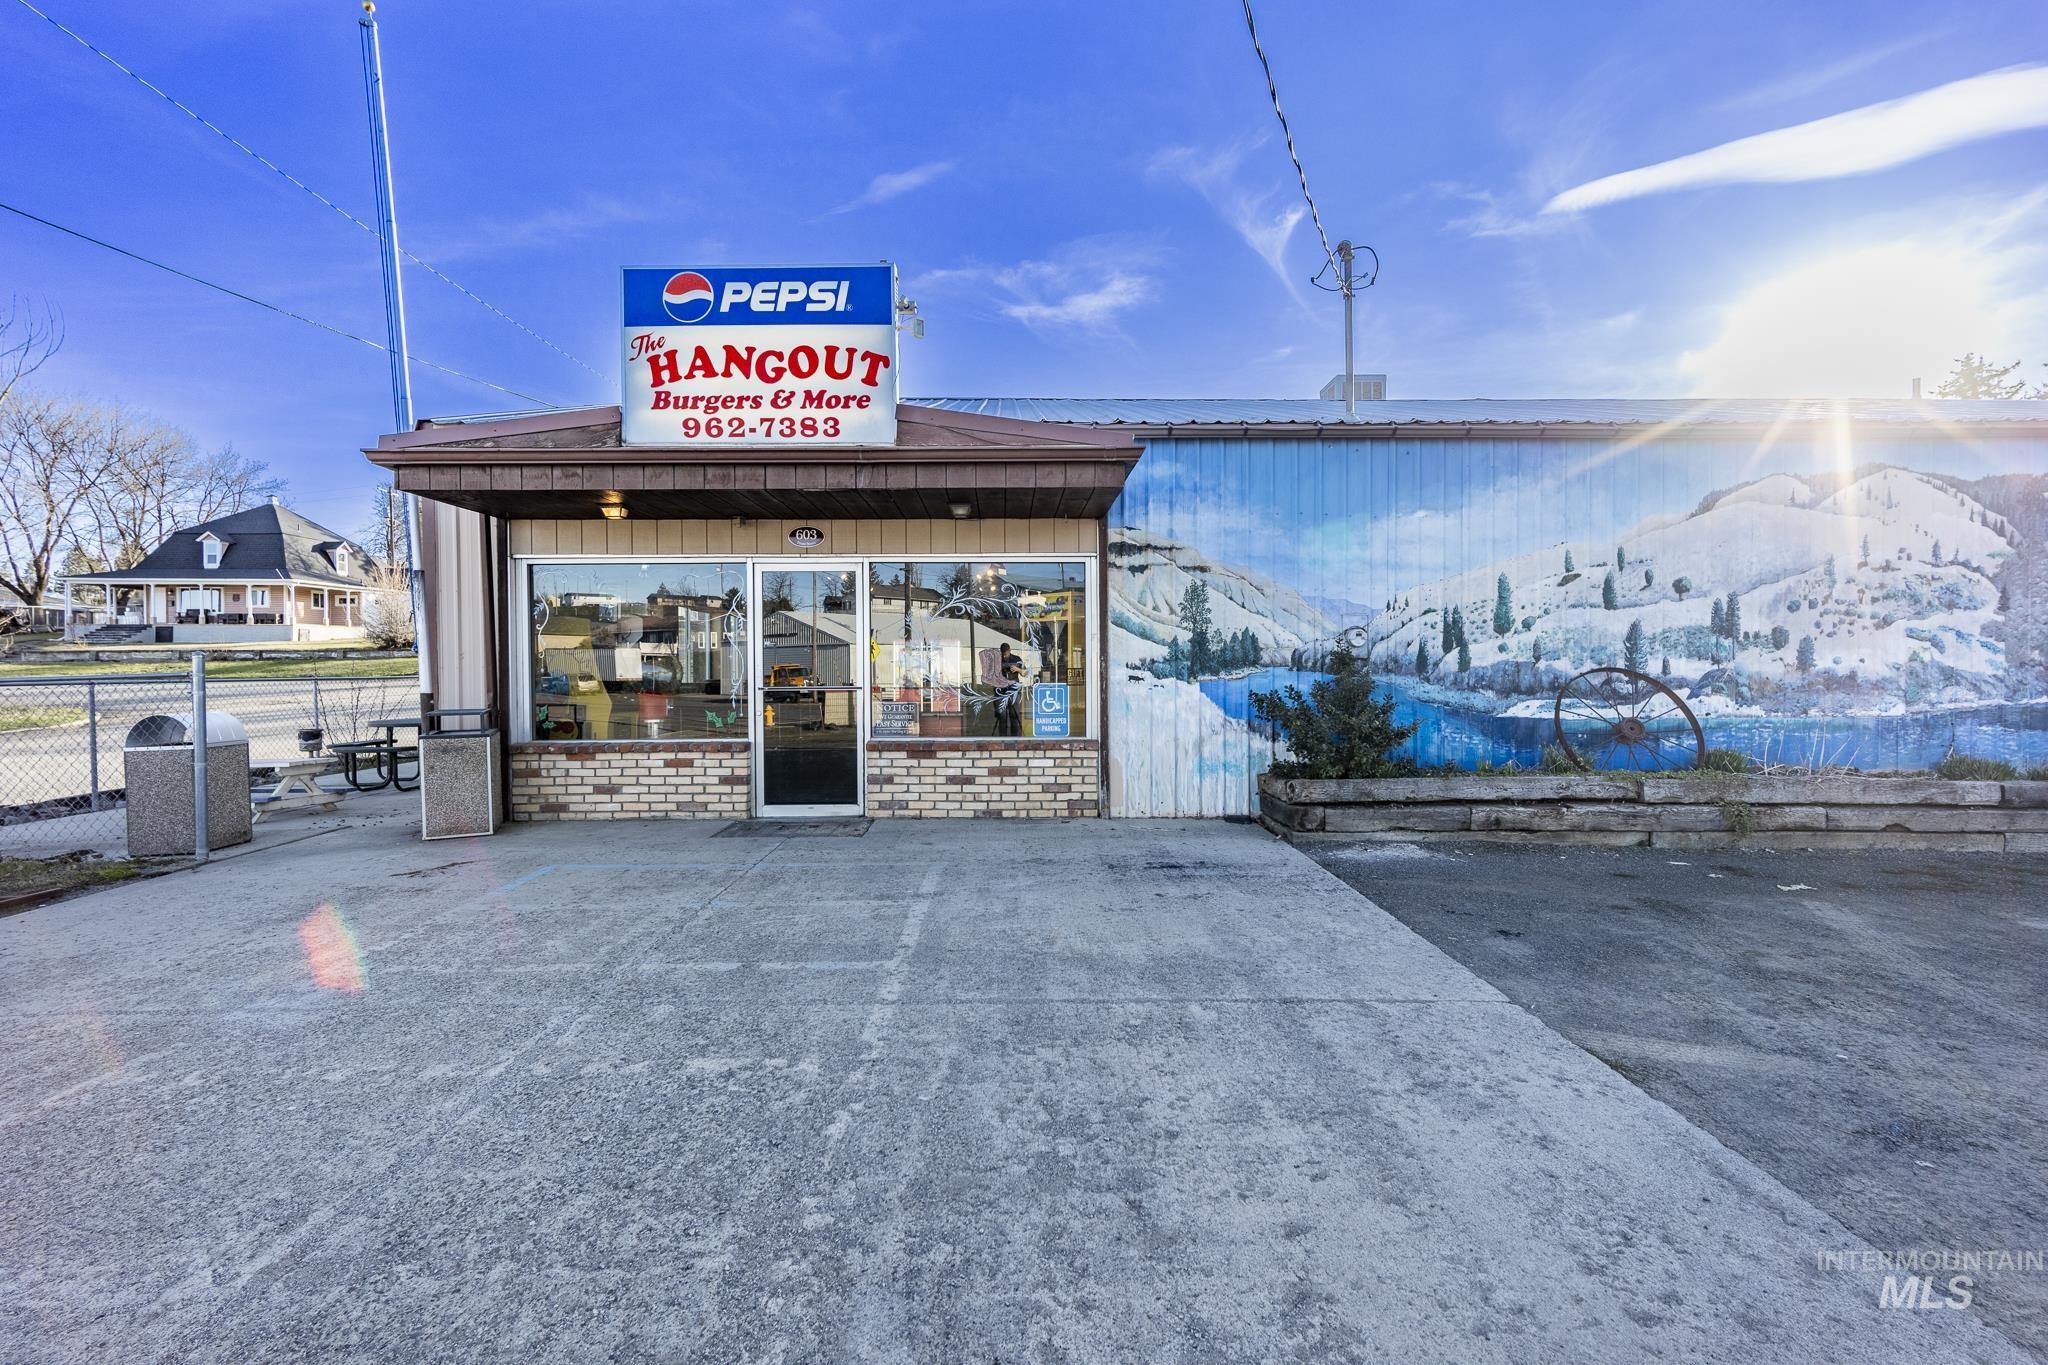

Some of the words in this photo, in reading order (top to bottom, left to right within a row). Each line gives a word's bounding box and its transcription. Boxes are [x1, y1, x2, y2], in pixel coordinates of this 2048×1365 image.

[719, 280, 850, 313] PEPSI
[629, 331, 666, 361] The
[646, 344, 890, 388] HANGOUT
[650, 390, 763, 414] Burgers
[770, 389, 796, 410] &
[800, 389, 871, 410] More
[682, 416, 841, 438] 962-7383
[796, 529, 817, 540] 603
[877, 704, 915, 712] NOTICE
